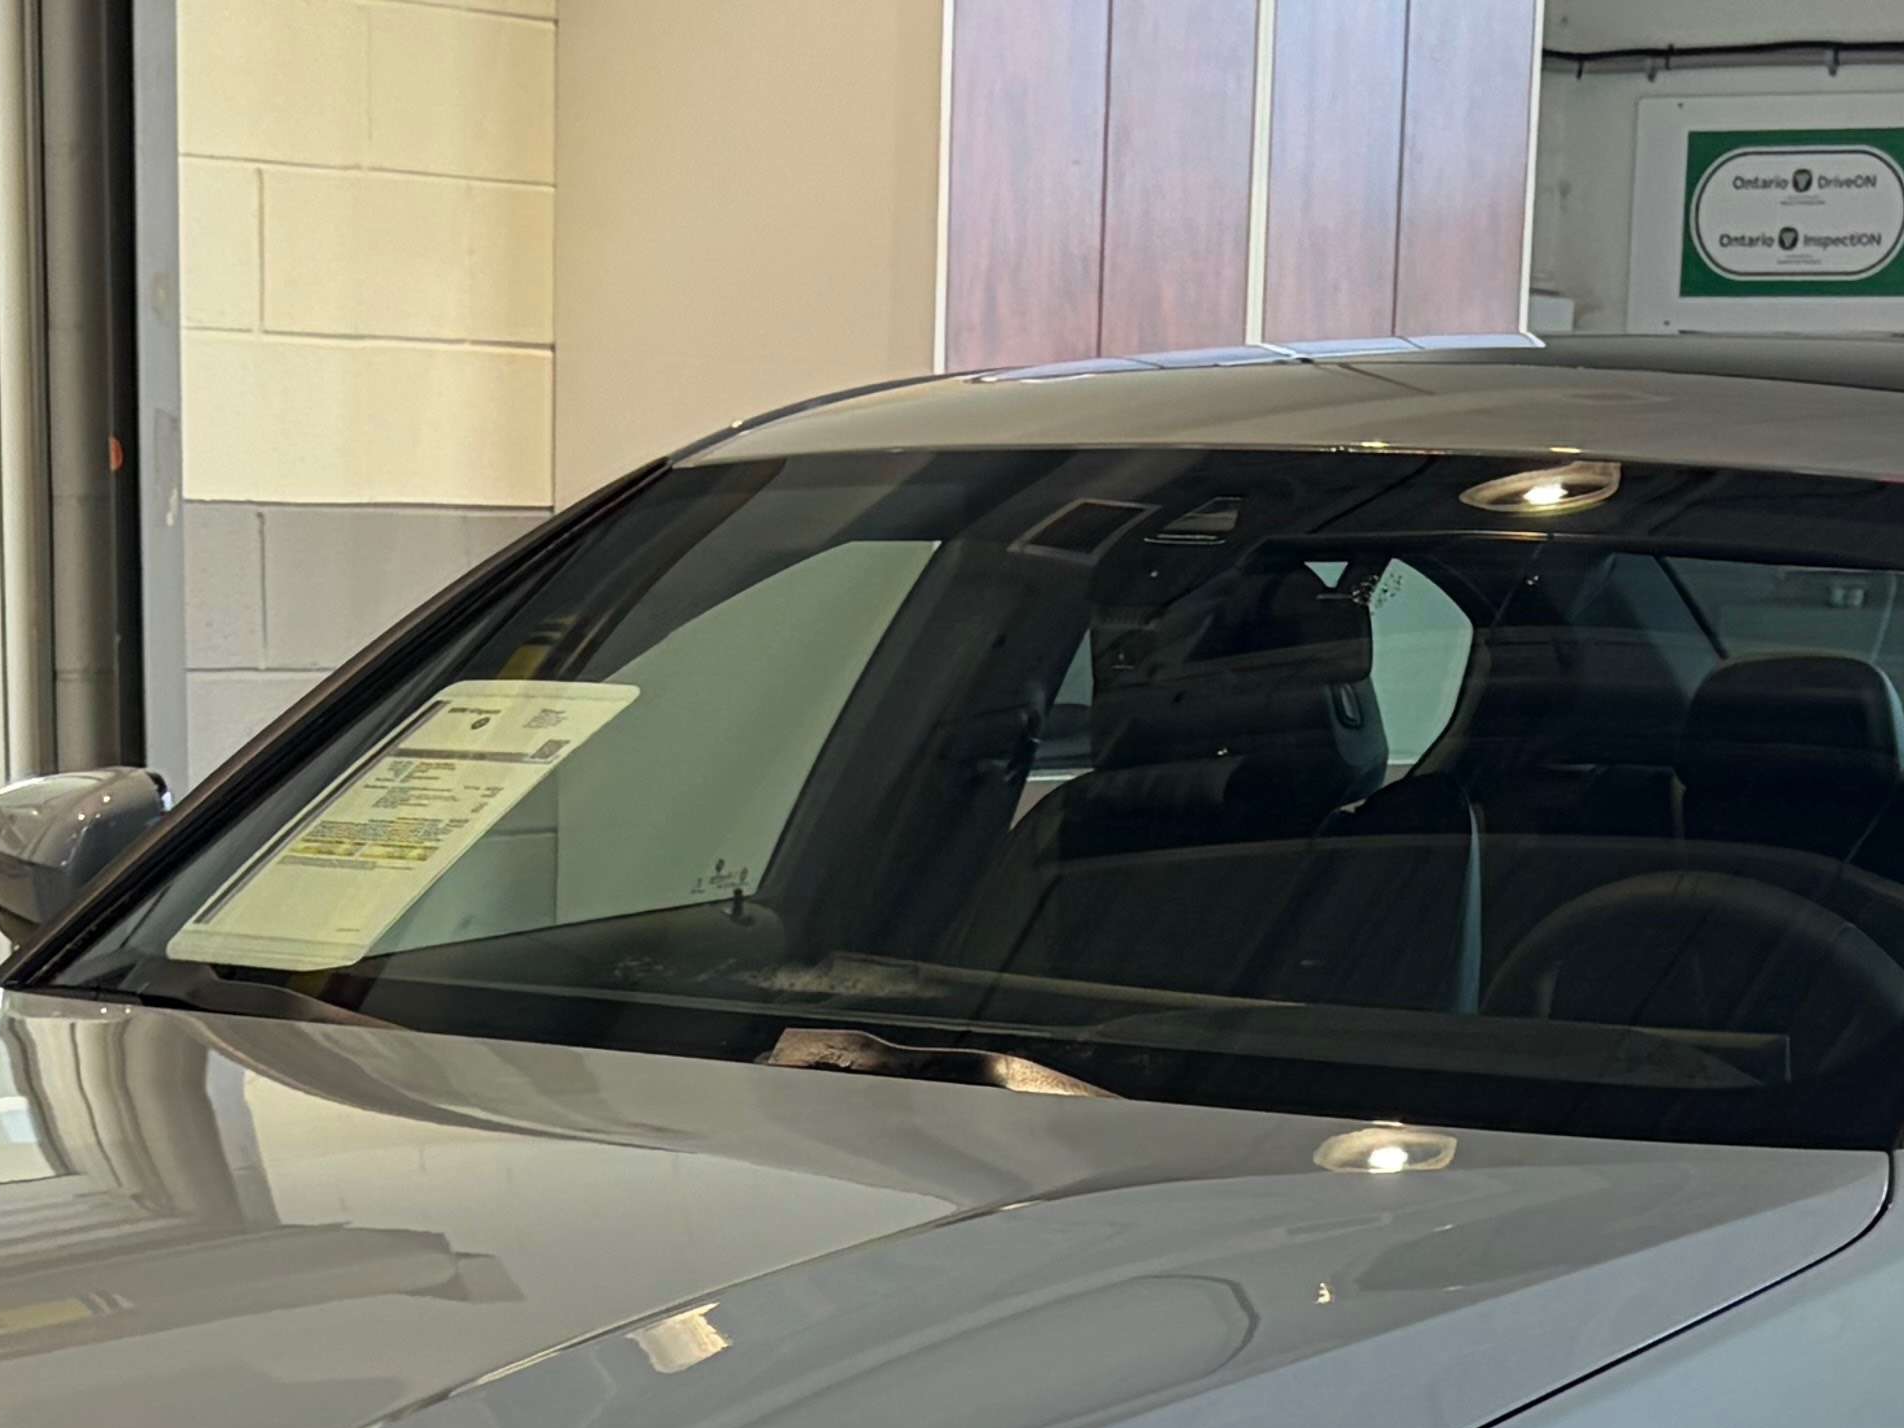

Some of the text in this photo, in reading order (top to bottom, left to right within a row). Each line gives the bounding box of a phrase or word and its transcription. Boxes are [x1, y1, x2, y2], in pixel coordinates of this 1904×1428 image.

[1732, 174, 1878, 190] Ontario DriveON
[1719, 233, 1775, 248] Ontario
